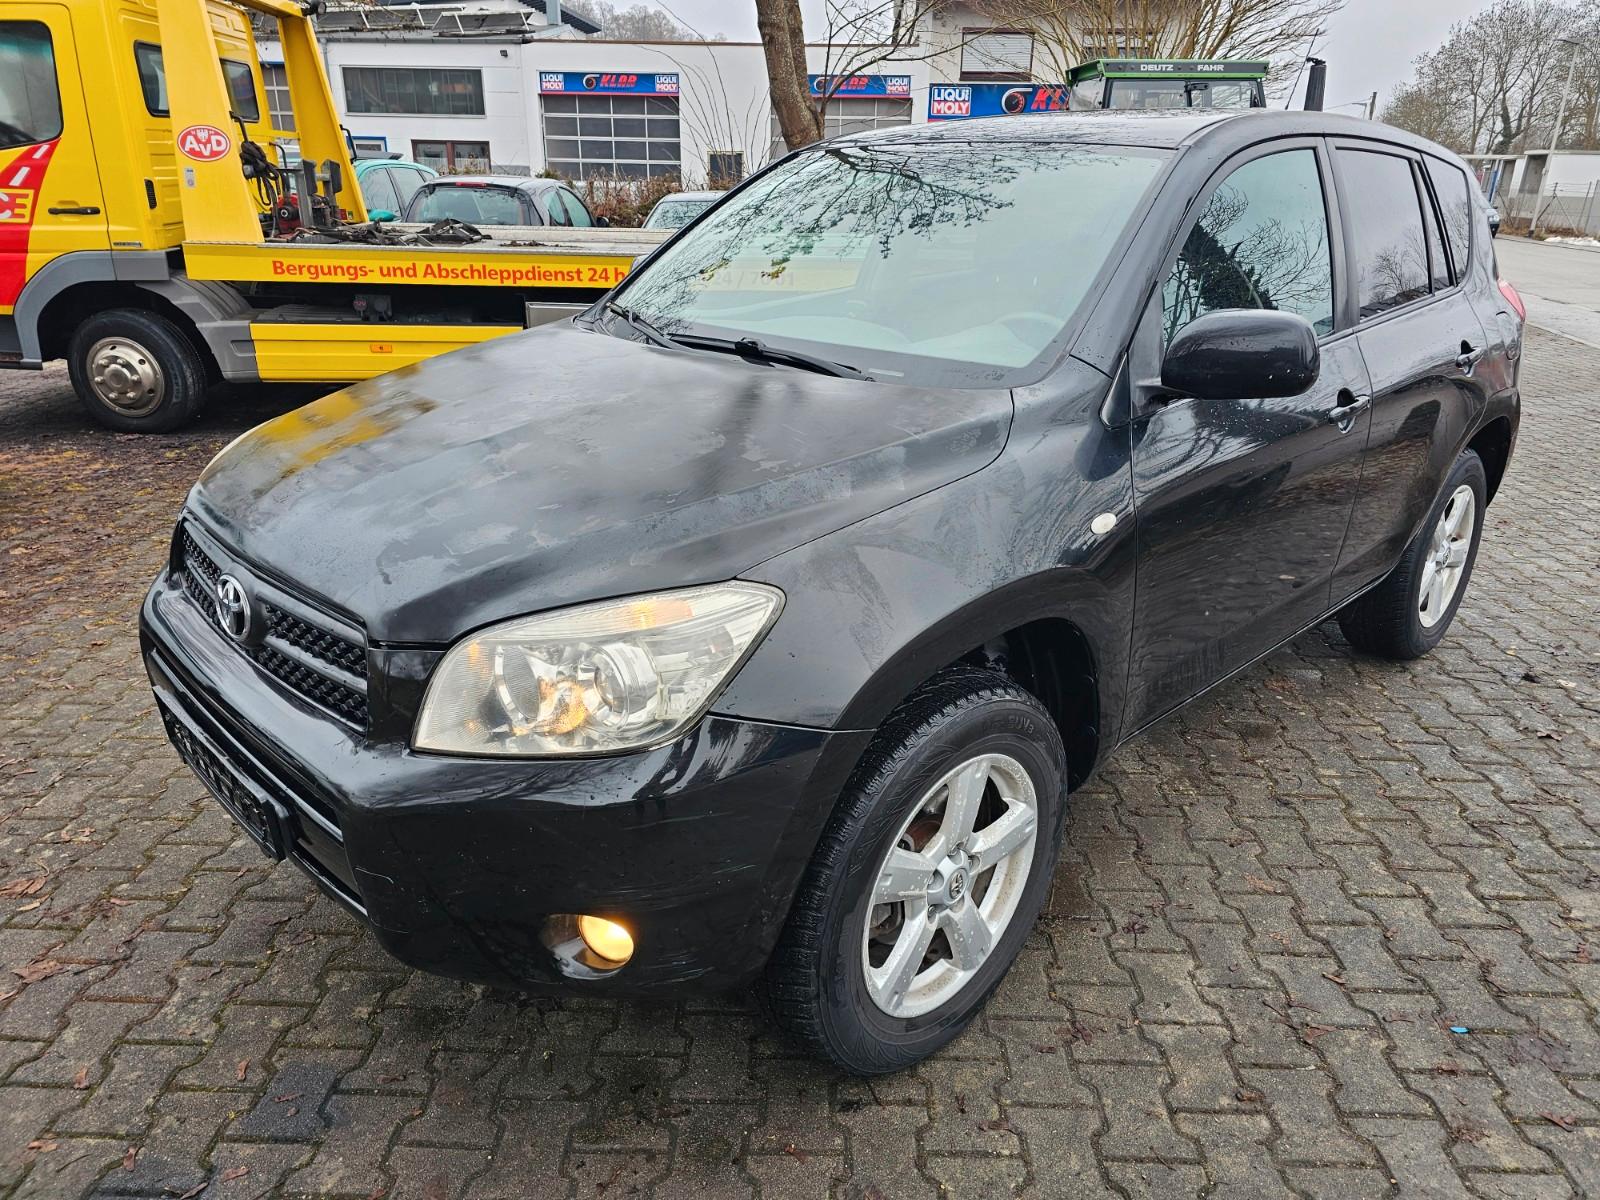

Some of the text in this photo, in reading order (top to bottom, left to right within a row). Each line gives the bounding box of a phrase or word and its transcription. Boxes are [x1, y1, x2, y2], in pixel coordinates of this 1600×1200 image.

[542, 82, 563, 90] MOLY
[656, 83, 677, 91] MOLY
[887, 85, 908, 93] MOLY
[933, 101, 970, 114] MOLY
[272, 260, 374, 280] Bergungs-
[379, 262, 417, 278] und
[423, 263, 583, 284] Abschleppdienst
[588, 267, 610, 282] 24
